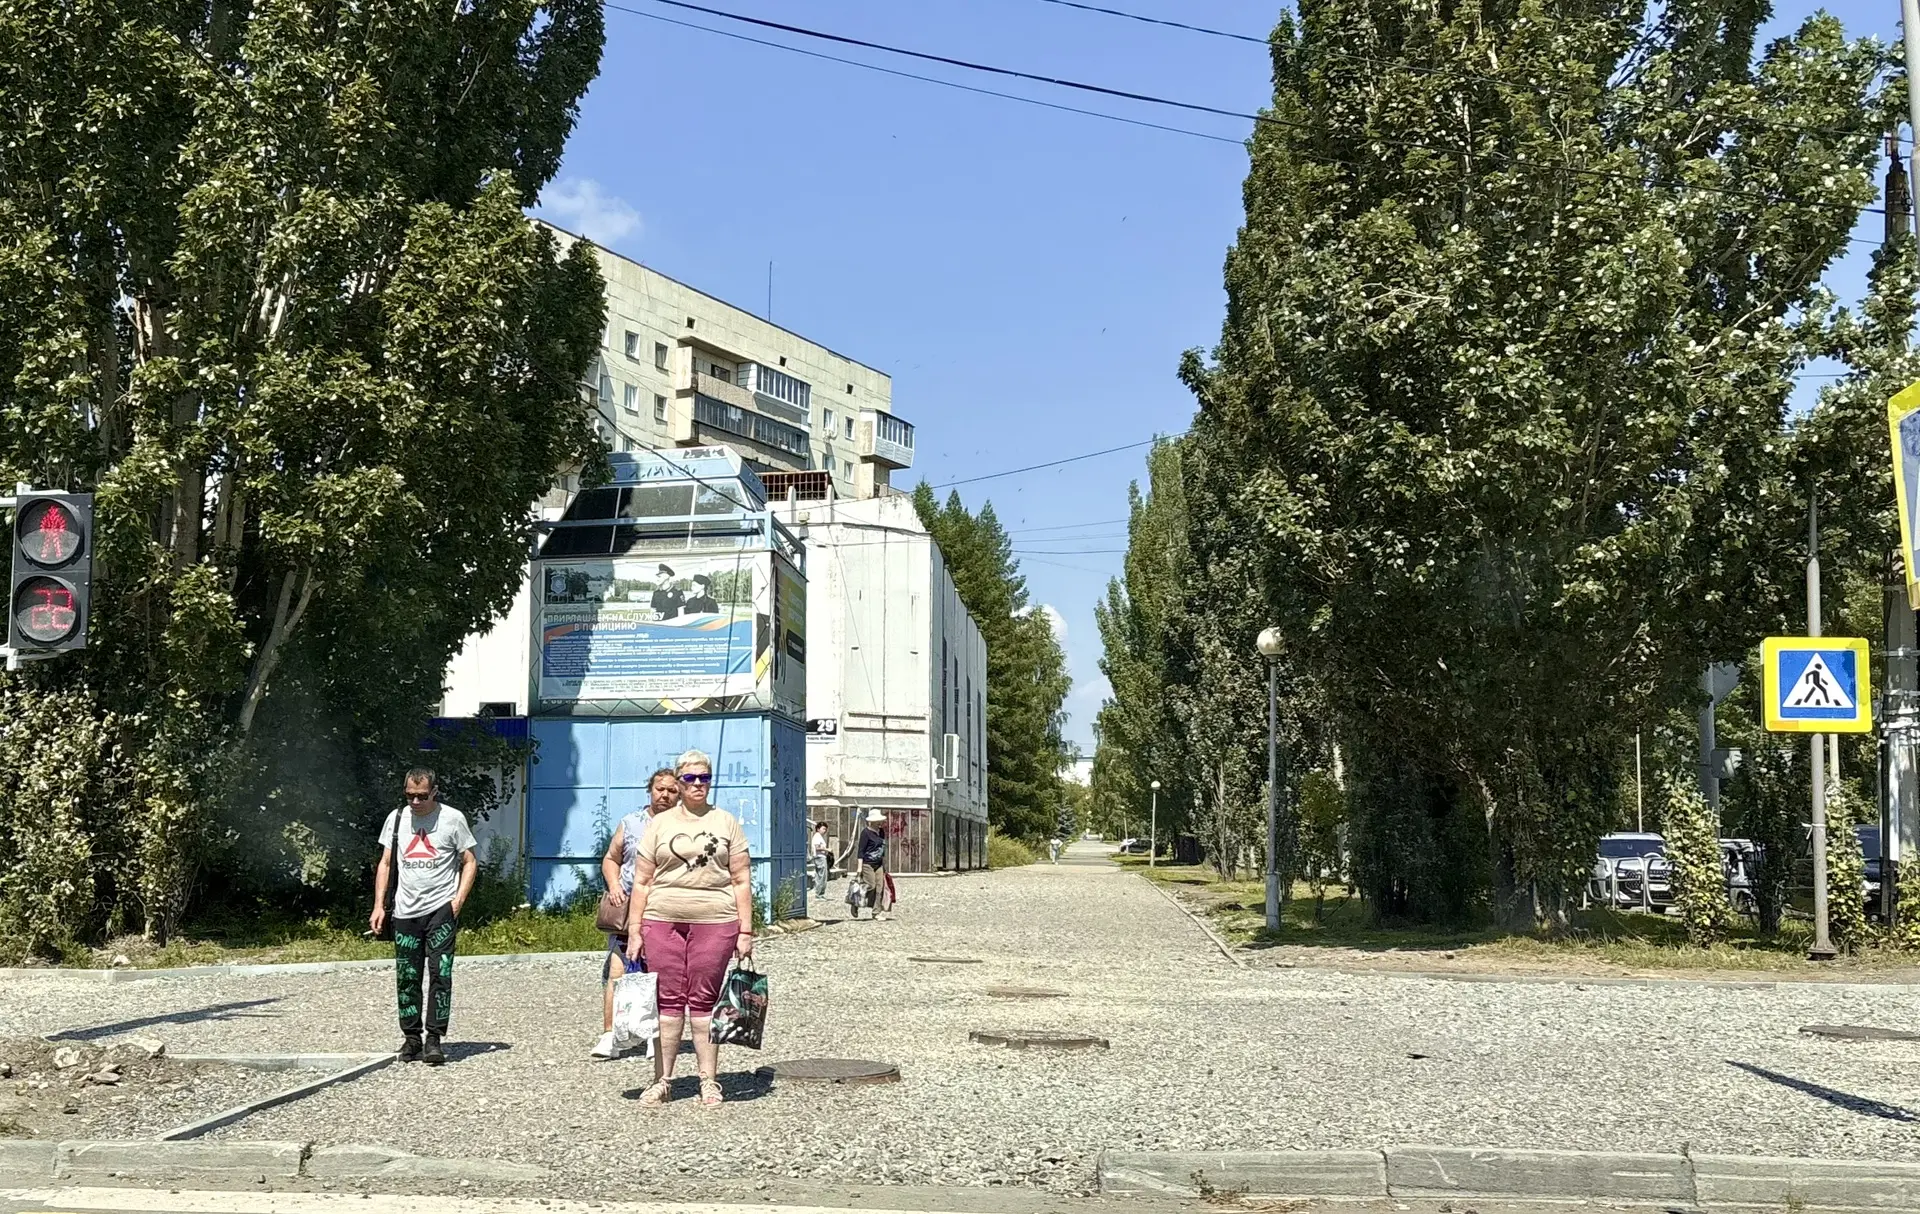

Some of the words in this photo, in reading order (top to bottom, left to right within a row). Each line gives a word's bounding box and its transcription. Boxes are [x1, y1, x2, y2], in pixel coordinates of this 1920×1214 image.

[547, 613, 610, 623] ПРИГЛАШАЕМ
[612, 613, 624, 622] НА
[627, 611, 665, 621] СЛУЖБУ
[574, 623, 580, 632] В
[402, 859, 440, 870] Reebok
